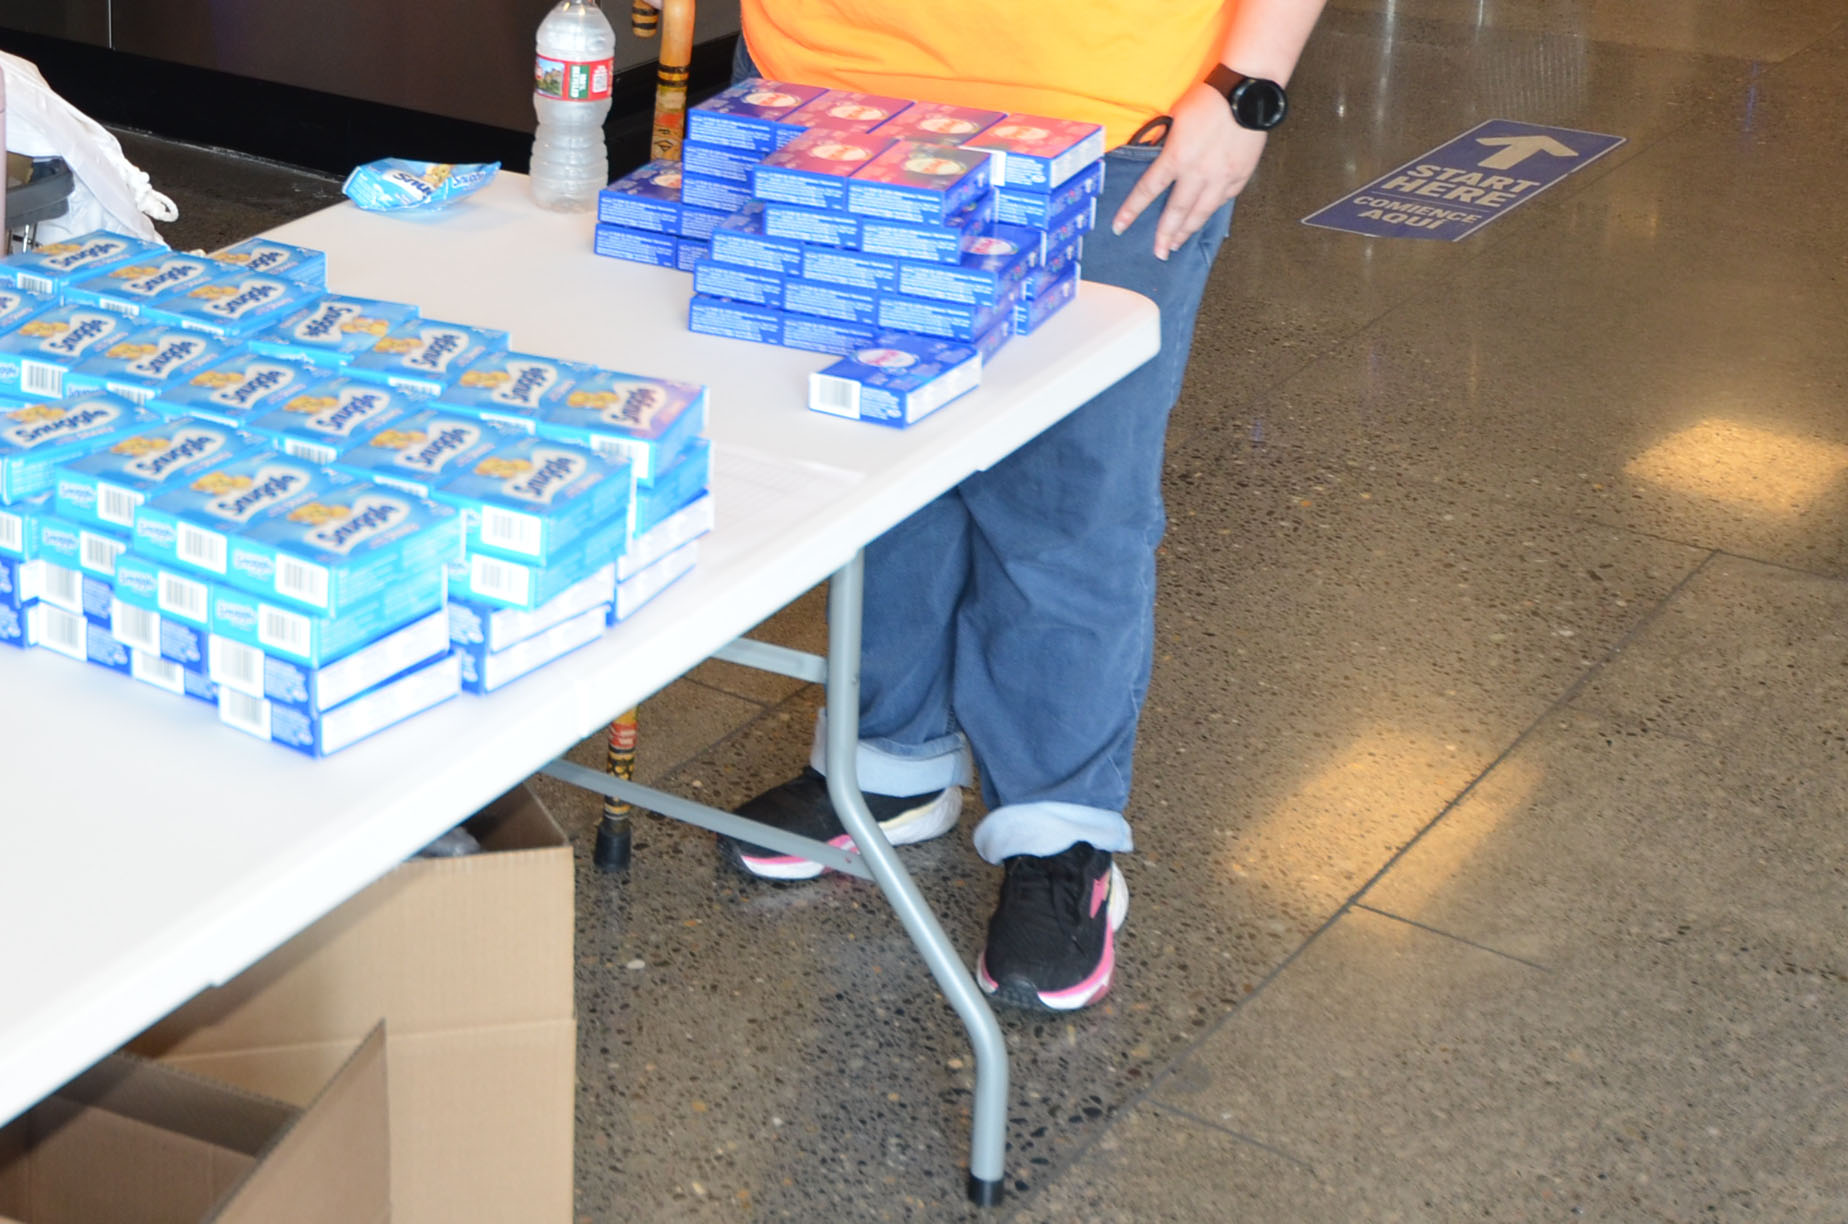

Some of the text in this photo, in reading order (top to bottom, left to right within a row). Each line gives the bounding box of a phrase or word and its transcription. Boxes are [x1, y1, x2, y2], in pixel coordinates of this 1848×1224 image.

[1380, 176, 1520, 209] HERE
[1406, 163, 1541, 195] START
[1352, 194, 1484, 225] COMIENCE
[47, 240, 122, 271] Snuggle
[248, 250, 289, 273] uggle
[130, 263, 198, 295] Snuggle
[213, 282, 279, 317] Snuggle
[48, 317, 110, 355] Snuggle
[302, 305, 354, 339] Snuggle
[136, 338, 197, 377] Snuggle
[411, 331, 458, 368] Snuggle
[221, 369, 283, 407] Snuggle
[498, 365, 548, 403] Snuggle
[14, 407, 110, 442] Snuggle
[316, 392, 380, 431] Snuggle
[611, 388, 659, 426] Snuggle
[136, 434, 215, 476] Snuggle
[405, 427, 470, 467] Snuggle
[218, 473, 297, 517] Snuggle
[513, 456, 576, 497] Snuggle
[316, 505, 399, 546] Snuggle
